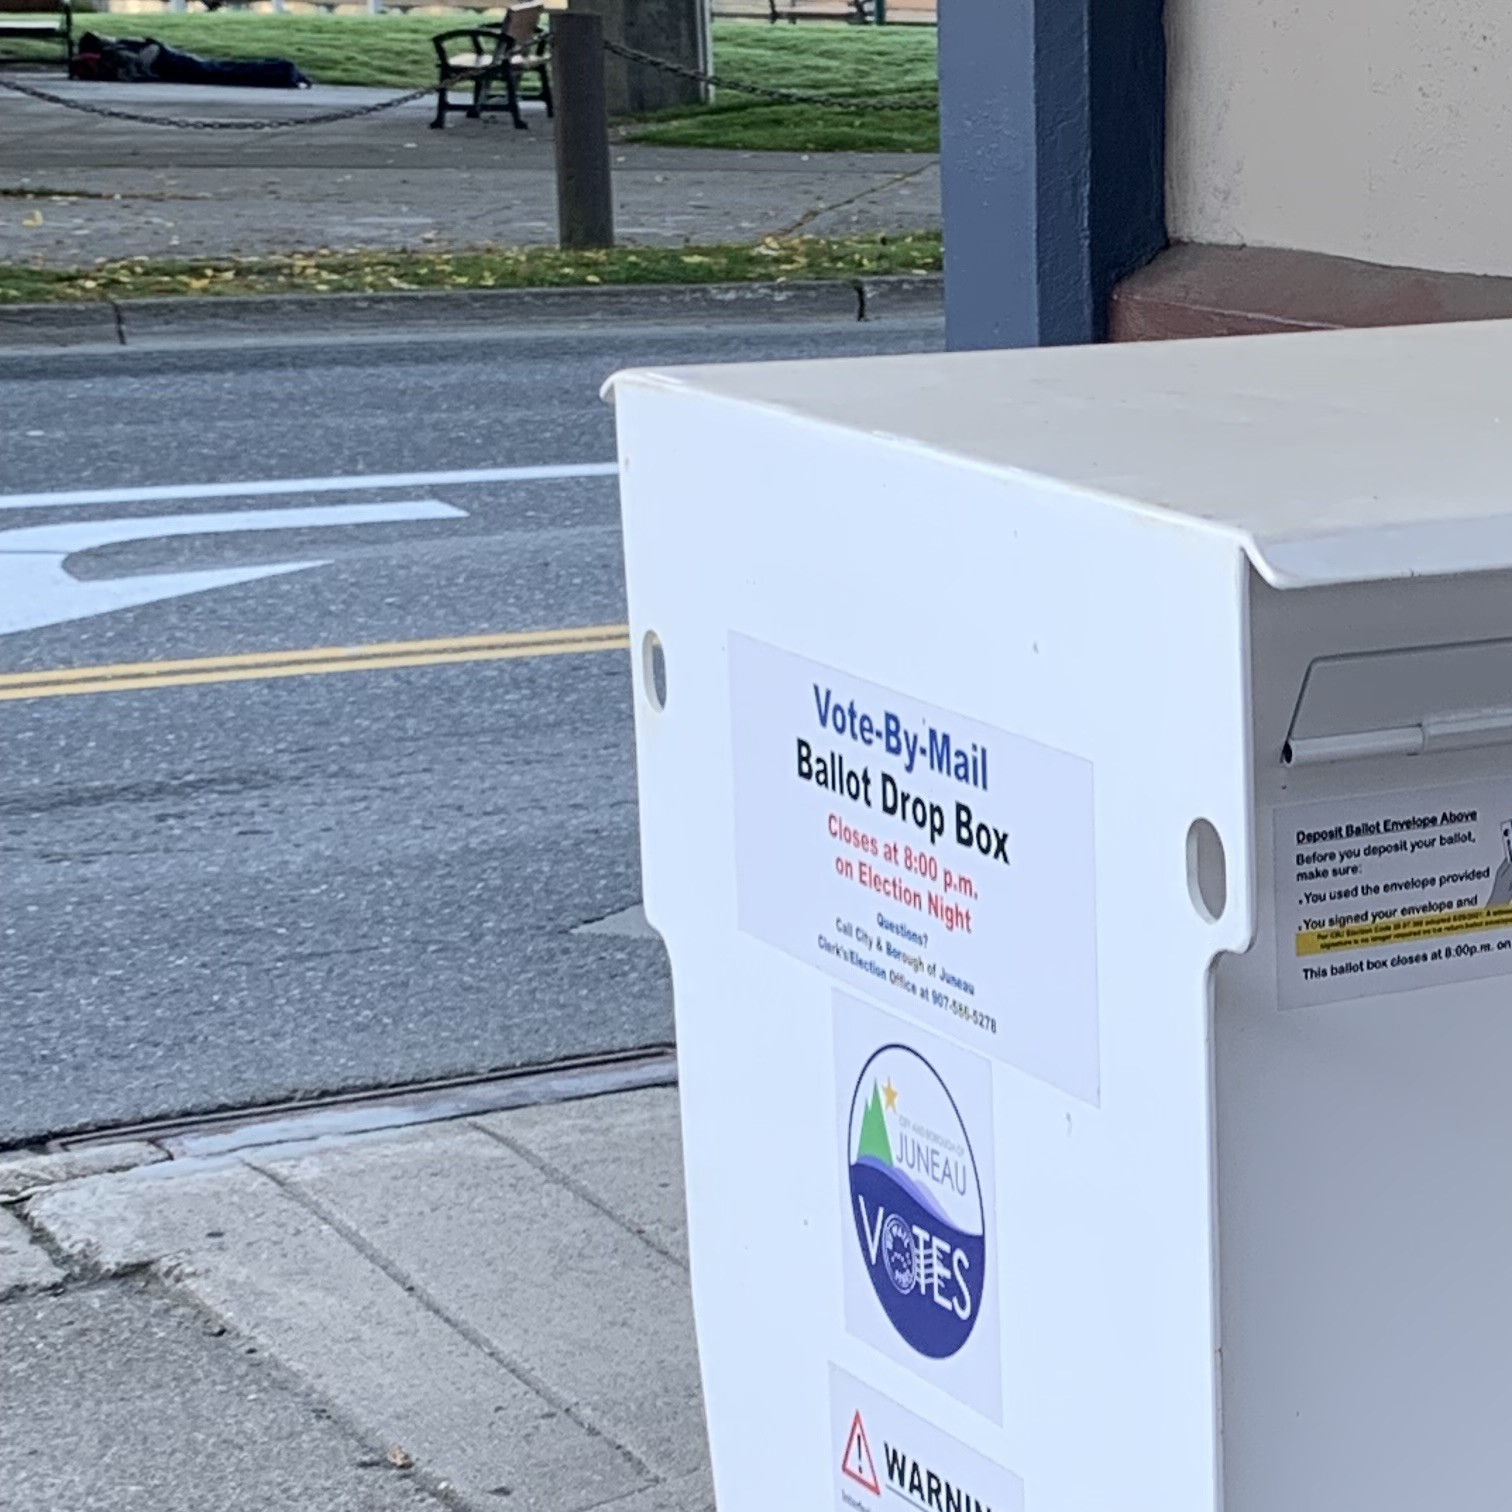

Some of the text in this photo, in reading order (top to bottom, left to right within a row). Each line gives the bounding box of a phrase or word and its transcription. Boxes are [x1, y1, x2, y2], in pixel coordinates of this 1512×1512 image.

[812, 683, 987, 791] Vote-By-Mail
[796, 737, 1009, 865] Ballot Drop Box
[1295, 809, 1477, 843] Deposit Ballot Envelope Above
[827, 812, 978, 900] Closes at 8:00 p.m.
[1295, 830, 1476, 866] Before you deposit your ballot,
[1295, 864, 1361, 882] make sure:
[1300, 865, 1490, 905] You used the envelope provided
[834, 856, 971, 933] on Election Night
[1299, 917, 1325, 931] You
[1327, 909, 1368, 927] signed
[1370, 907, 1397, 923] your
[1399, 899, 1453, 916] envelope
[1455, 893, 1478, 908] and
[875, 911, 928, 948] Questions?
[835, 916, 975, 996] Call City & Borough of Juneau
[1301, 966, 1328, 980] This
[1329, 959, 1364, 976] ballot
[1365, 958, 1388, 970] box
[1389, 951, 1428, 967] closes
[1430, 947, 1443, 961] at
[1496, 939, 1511, 950] on
[888, 968, 917, 995] Office
[919, 986, 929, 1001] at
[894, 1131, 966, 1197] JUNEAU
[858, 1194, 972, 1321] VOTES
